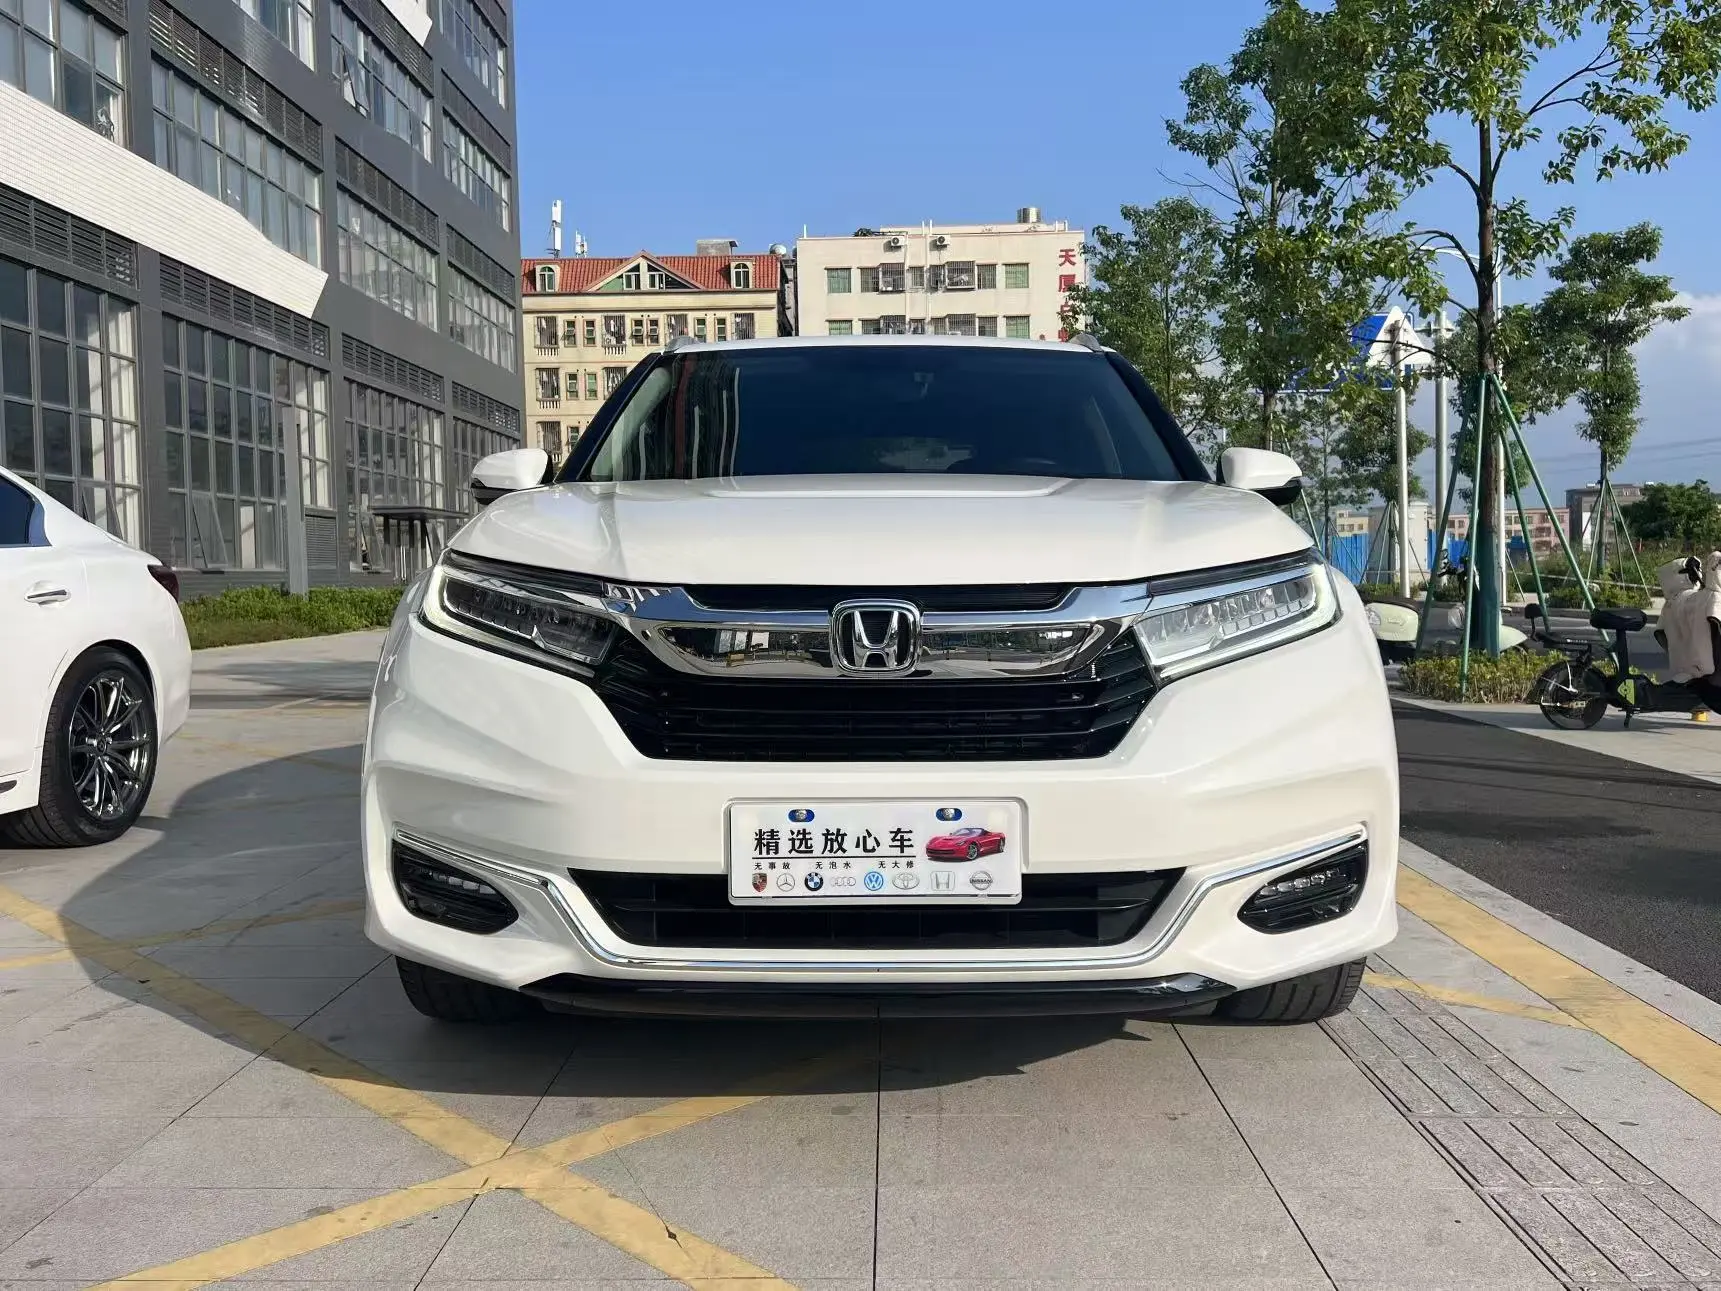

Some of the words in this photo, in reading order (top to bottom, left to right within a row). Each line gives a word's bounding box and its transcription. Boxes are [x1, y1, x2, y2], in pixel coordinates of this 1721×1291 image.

[754, 828, 914, 855] 精选放心车
[754, 861, 790, 870] 无事故
[815, 861, 851, 869] 无泡水
[878, 860, 914, 869] 无大修
